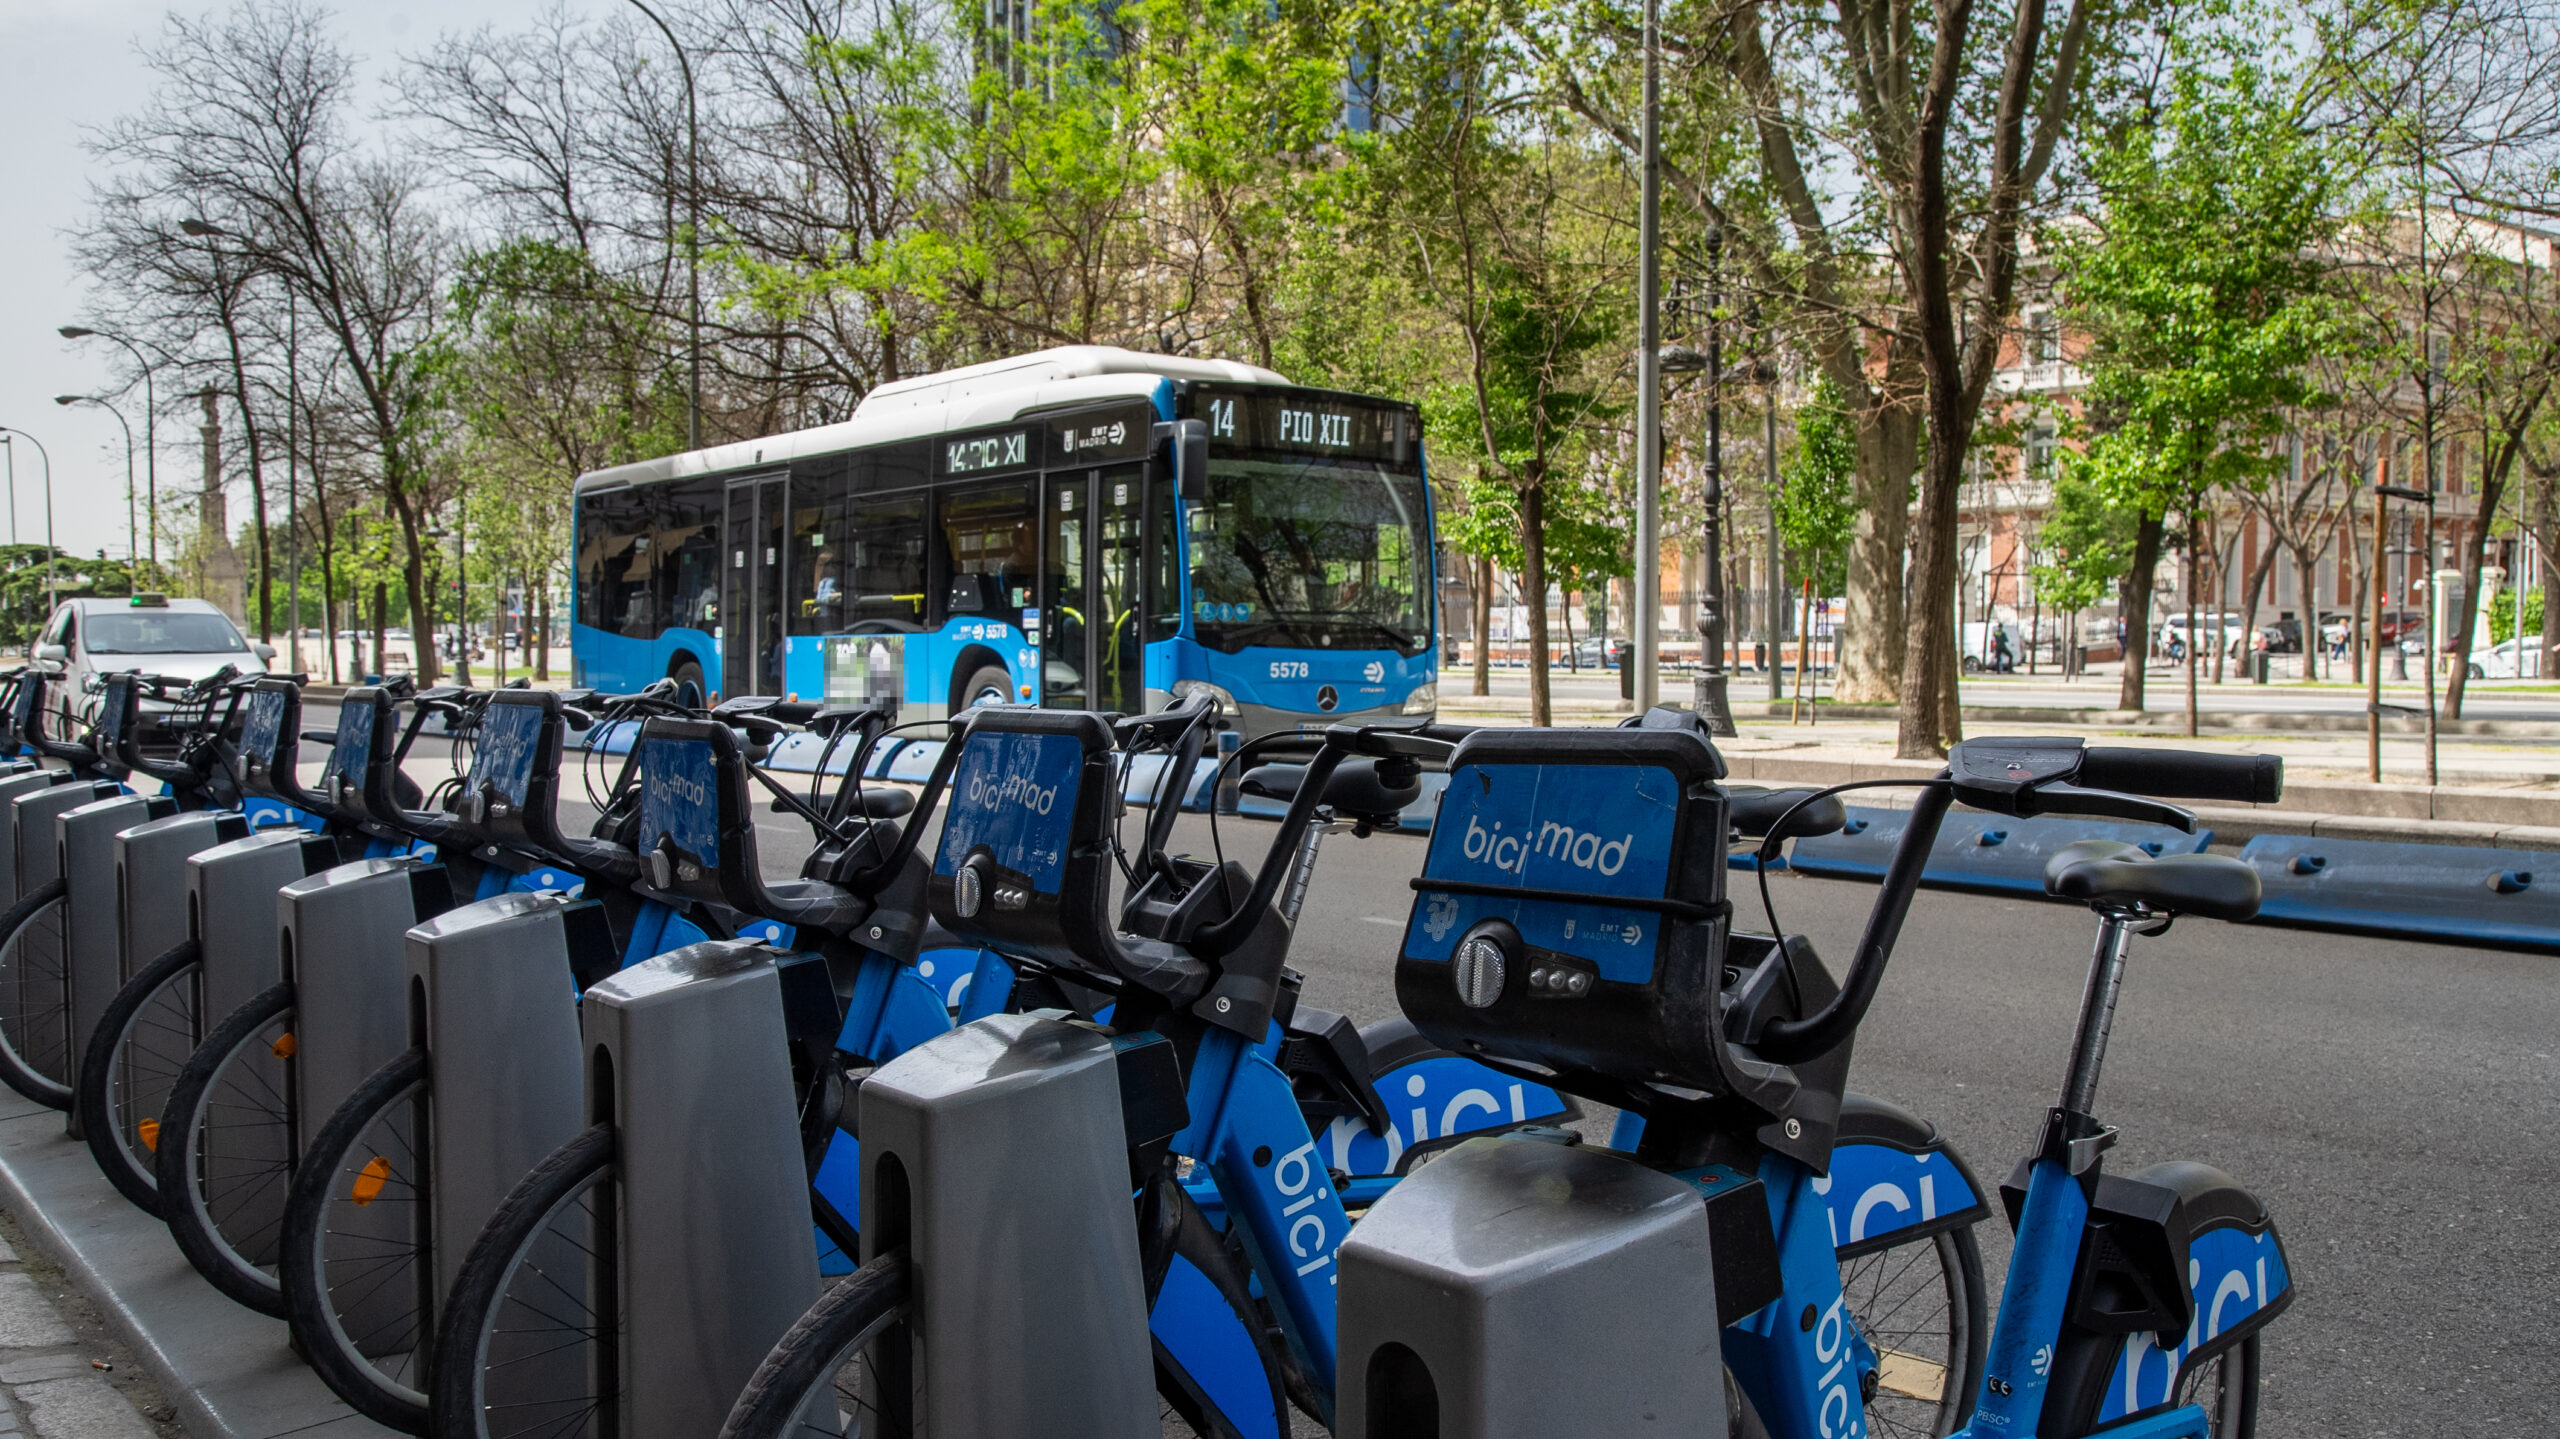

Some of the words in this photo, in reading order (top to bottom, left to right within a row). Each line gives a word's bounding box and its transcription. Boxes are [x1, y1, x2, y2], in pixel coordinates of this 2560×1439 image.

[1091, 425, 1108, 437] EMT
[1209, 398, 1236, 438] 14
[1279, 408, 1315, 444] PIO
[1318, 413, 1352, 447] XII
[1078, 436, 1108, 448] MADRID
[948, 443, 967, 474] 14
[1004, 433, 1026, 465] XII
[985, 623, 1008, 640] 5578
[1269, 661, 1310, 679] 5578
[1581, 930, 1619, 943] MADRID
[1600, 923, 1621, 933] EMT
[1274, 1141, 1338, 1284] bici
